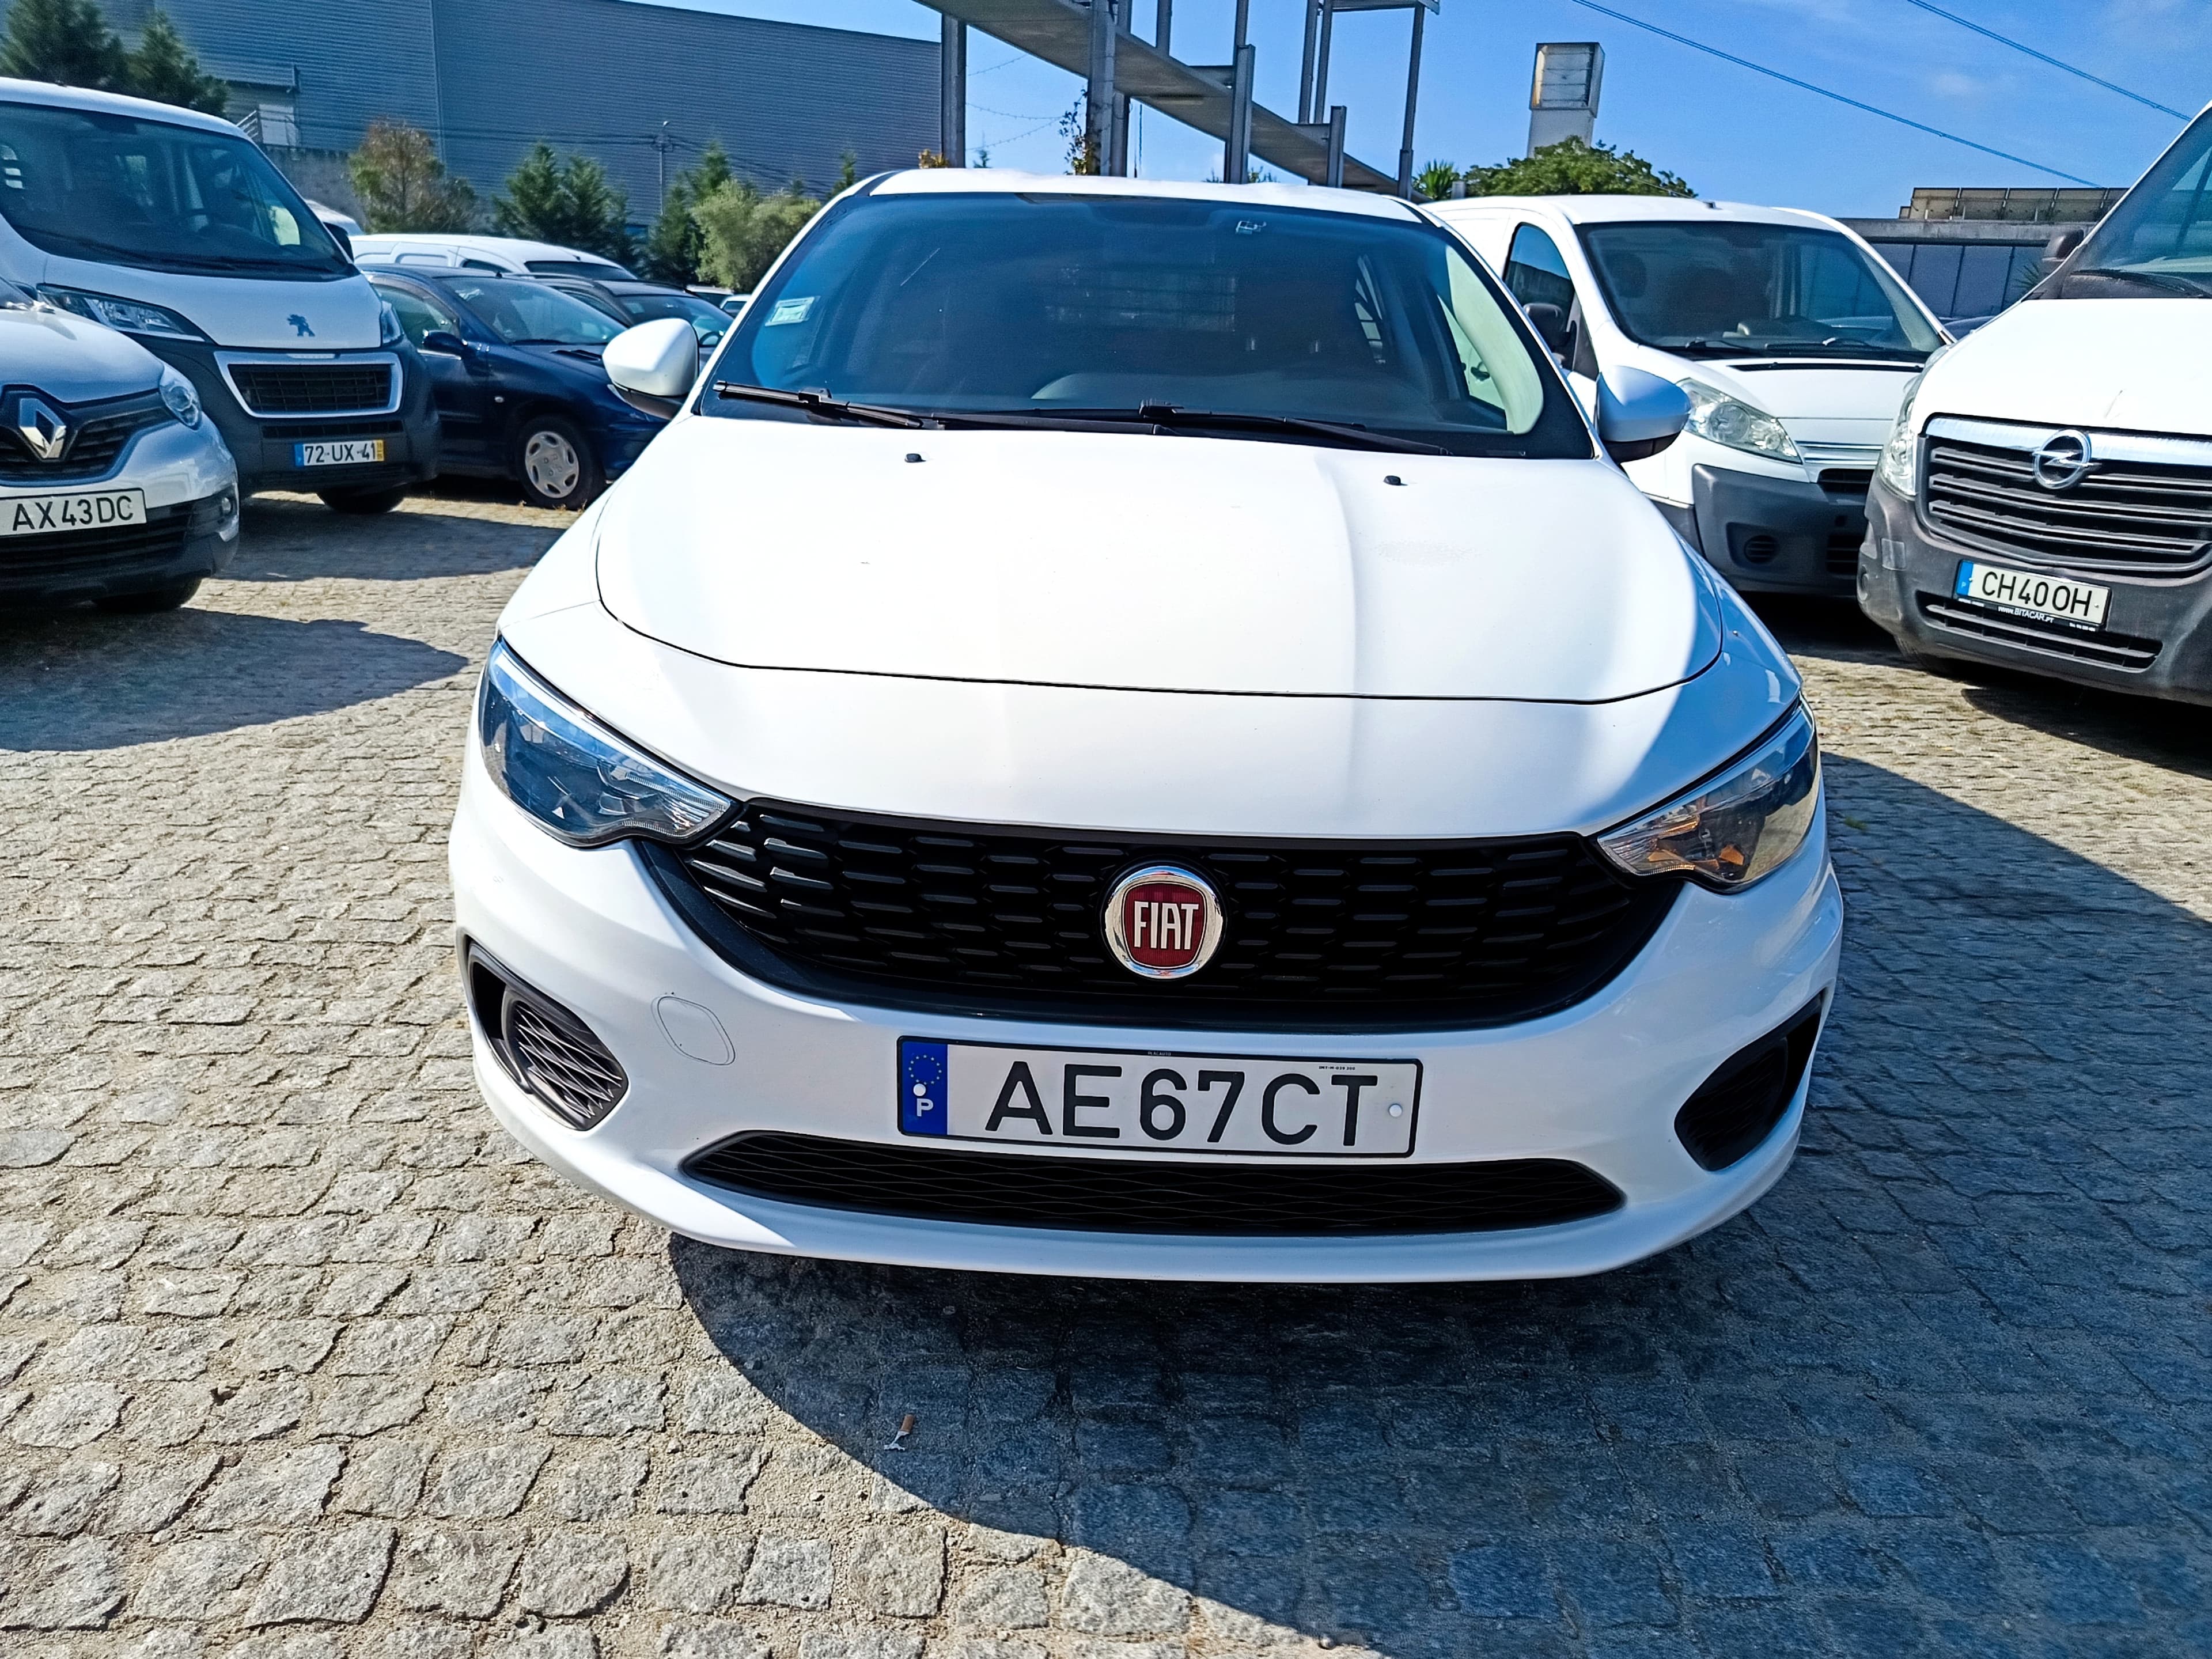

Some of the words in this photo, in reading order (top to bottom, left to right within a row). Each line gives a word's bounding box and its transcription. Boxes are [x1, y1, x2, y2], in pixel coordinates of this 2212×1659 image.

[12, 495, 134, 531] AX43DC
[1134, 900, 1199, 950] FIAT
[916, 1098, 934, 1117] P
[985, 1060, 1378, 1147] AE67CT
